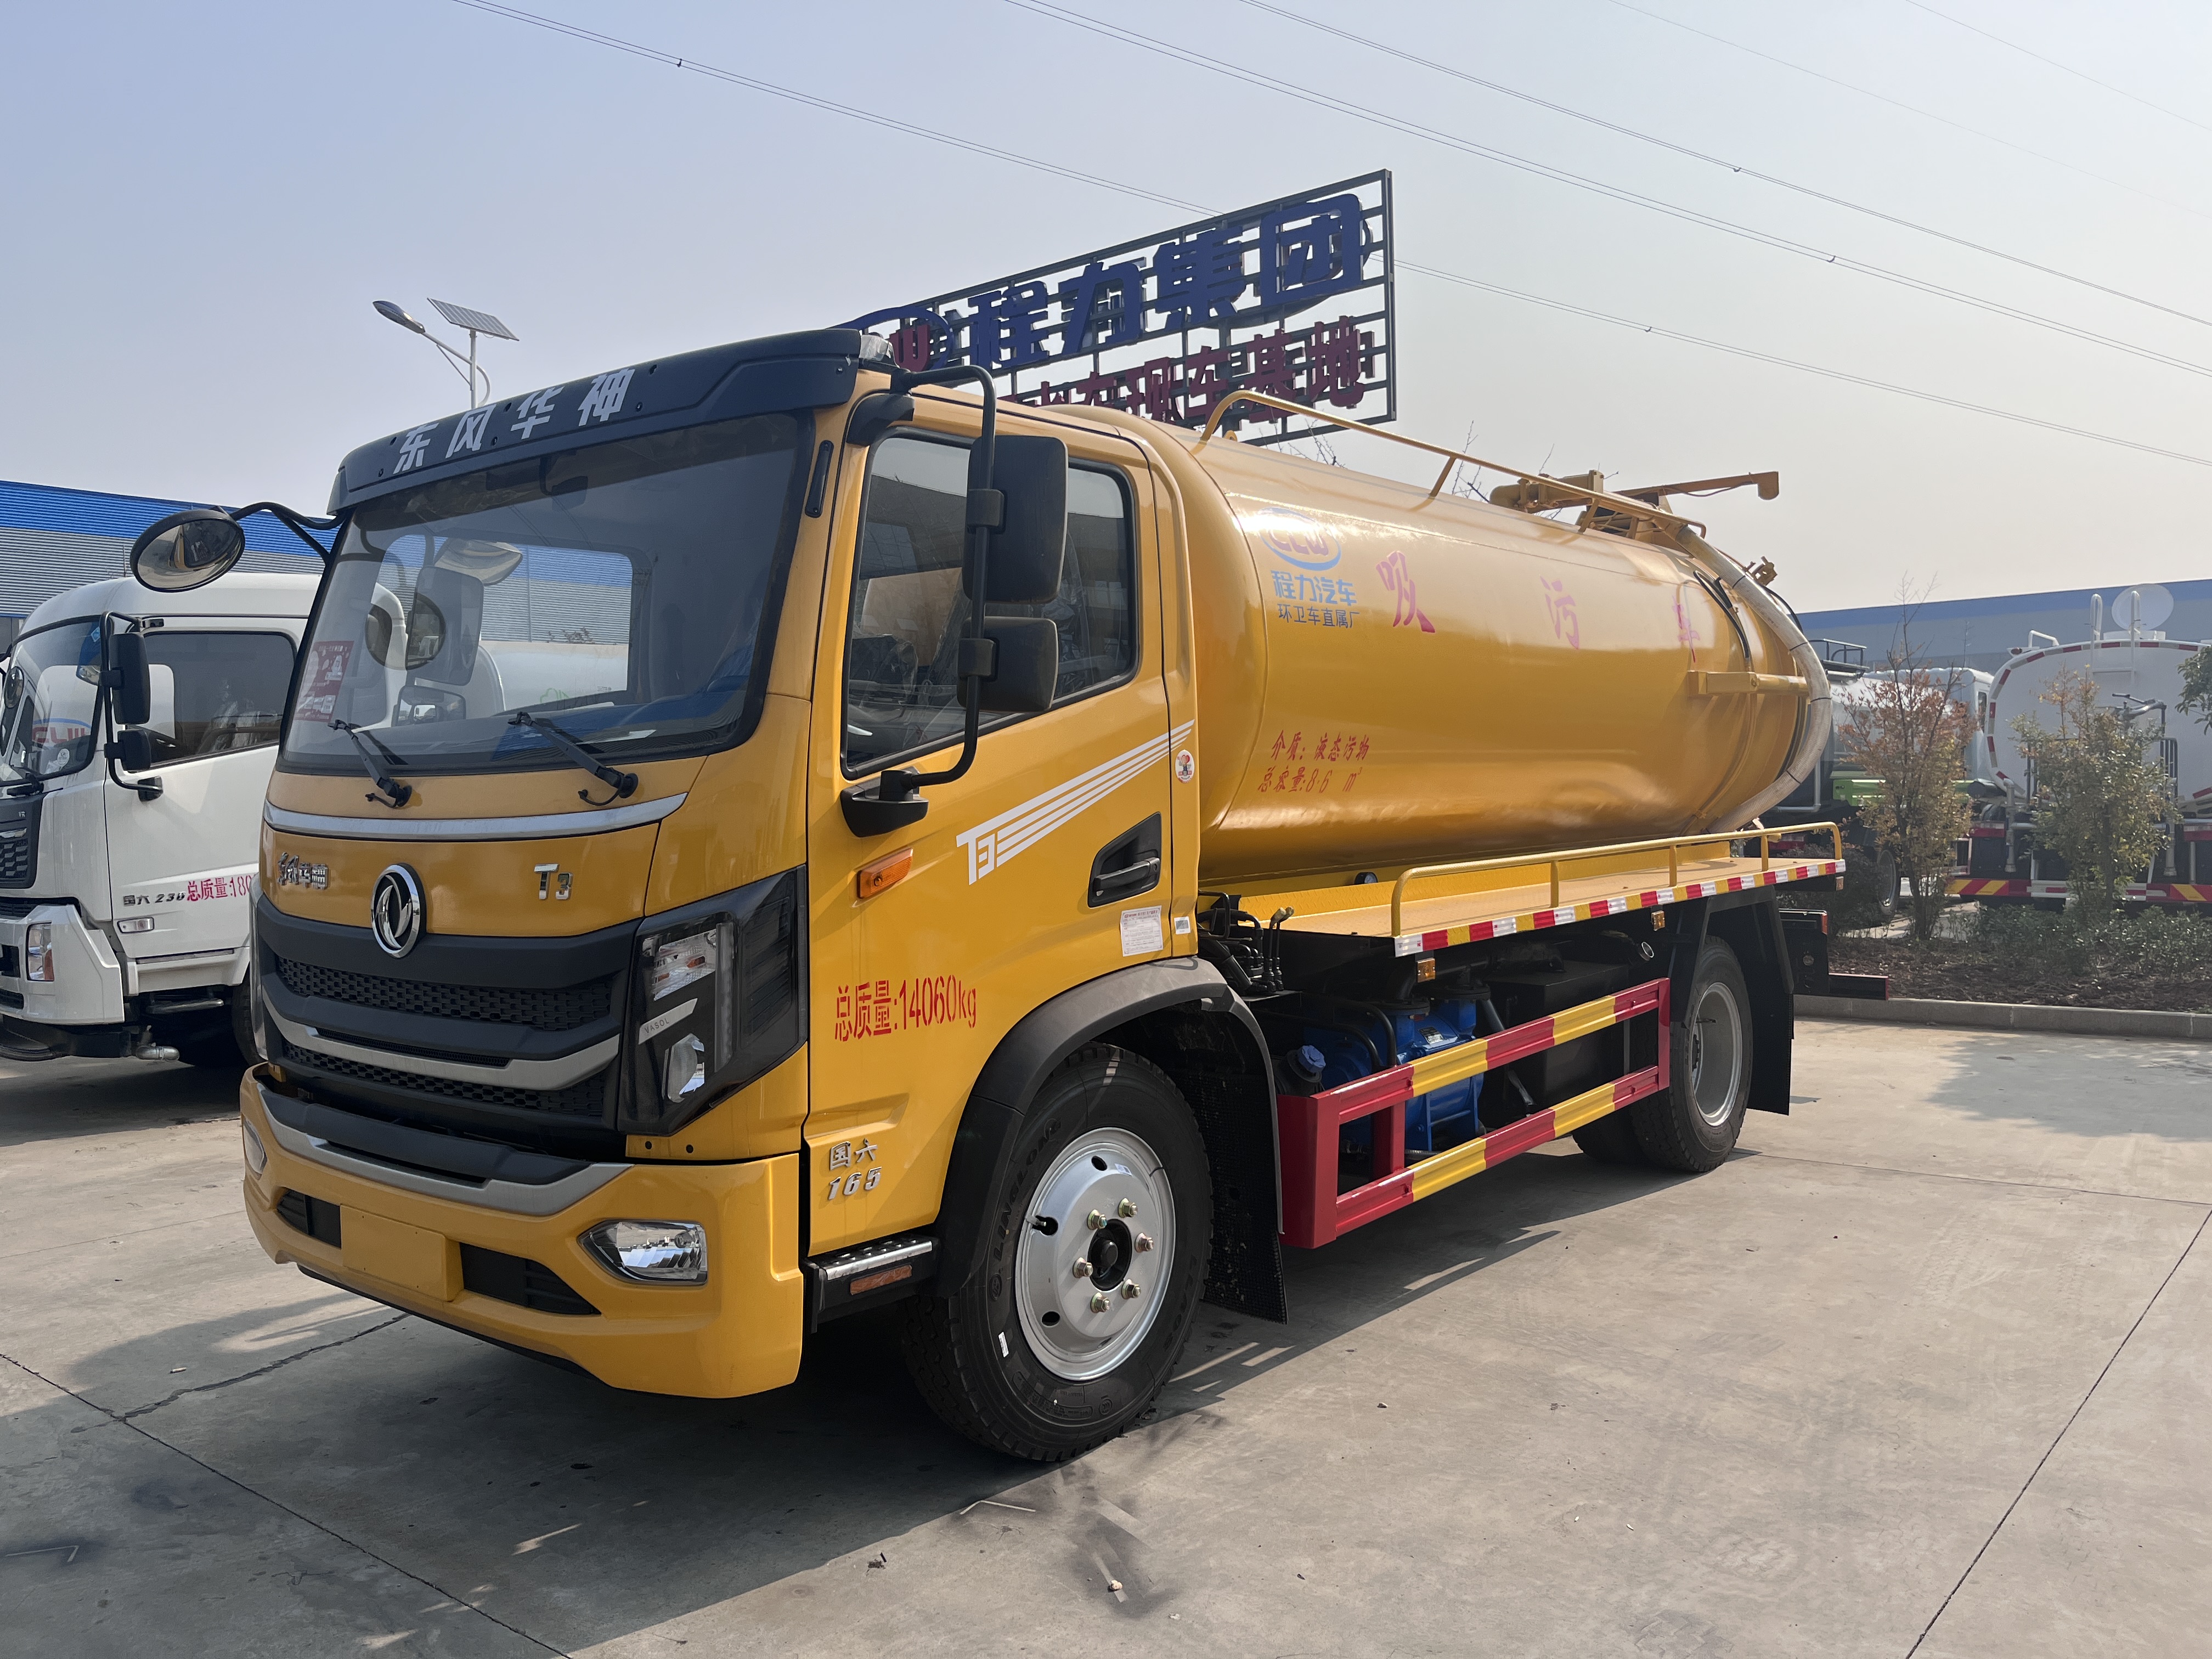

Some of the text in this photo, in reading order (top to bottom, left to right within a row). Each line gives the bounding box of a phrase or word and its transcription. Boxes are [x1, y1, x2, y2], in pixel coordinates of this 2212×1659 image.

[967, 193, 1364, 369] 程力集团
[393, 367, 635, 475] 东风华神
[1270, 569, 1357, 607] 程力汽车
[1277, 603, 1361, 629] 环卫车直属厂
[534, 863, 573, 900] T3
[122, 894, 151, 907] 国六
[644, 1018, 669, 1034] VASOL
[834, 975, 977, 1042] 总质量:14060kg
[828, 1138, 879, 1171] 国六
[827, 1166, 883, 1201] 165
